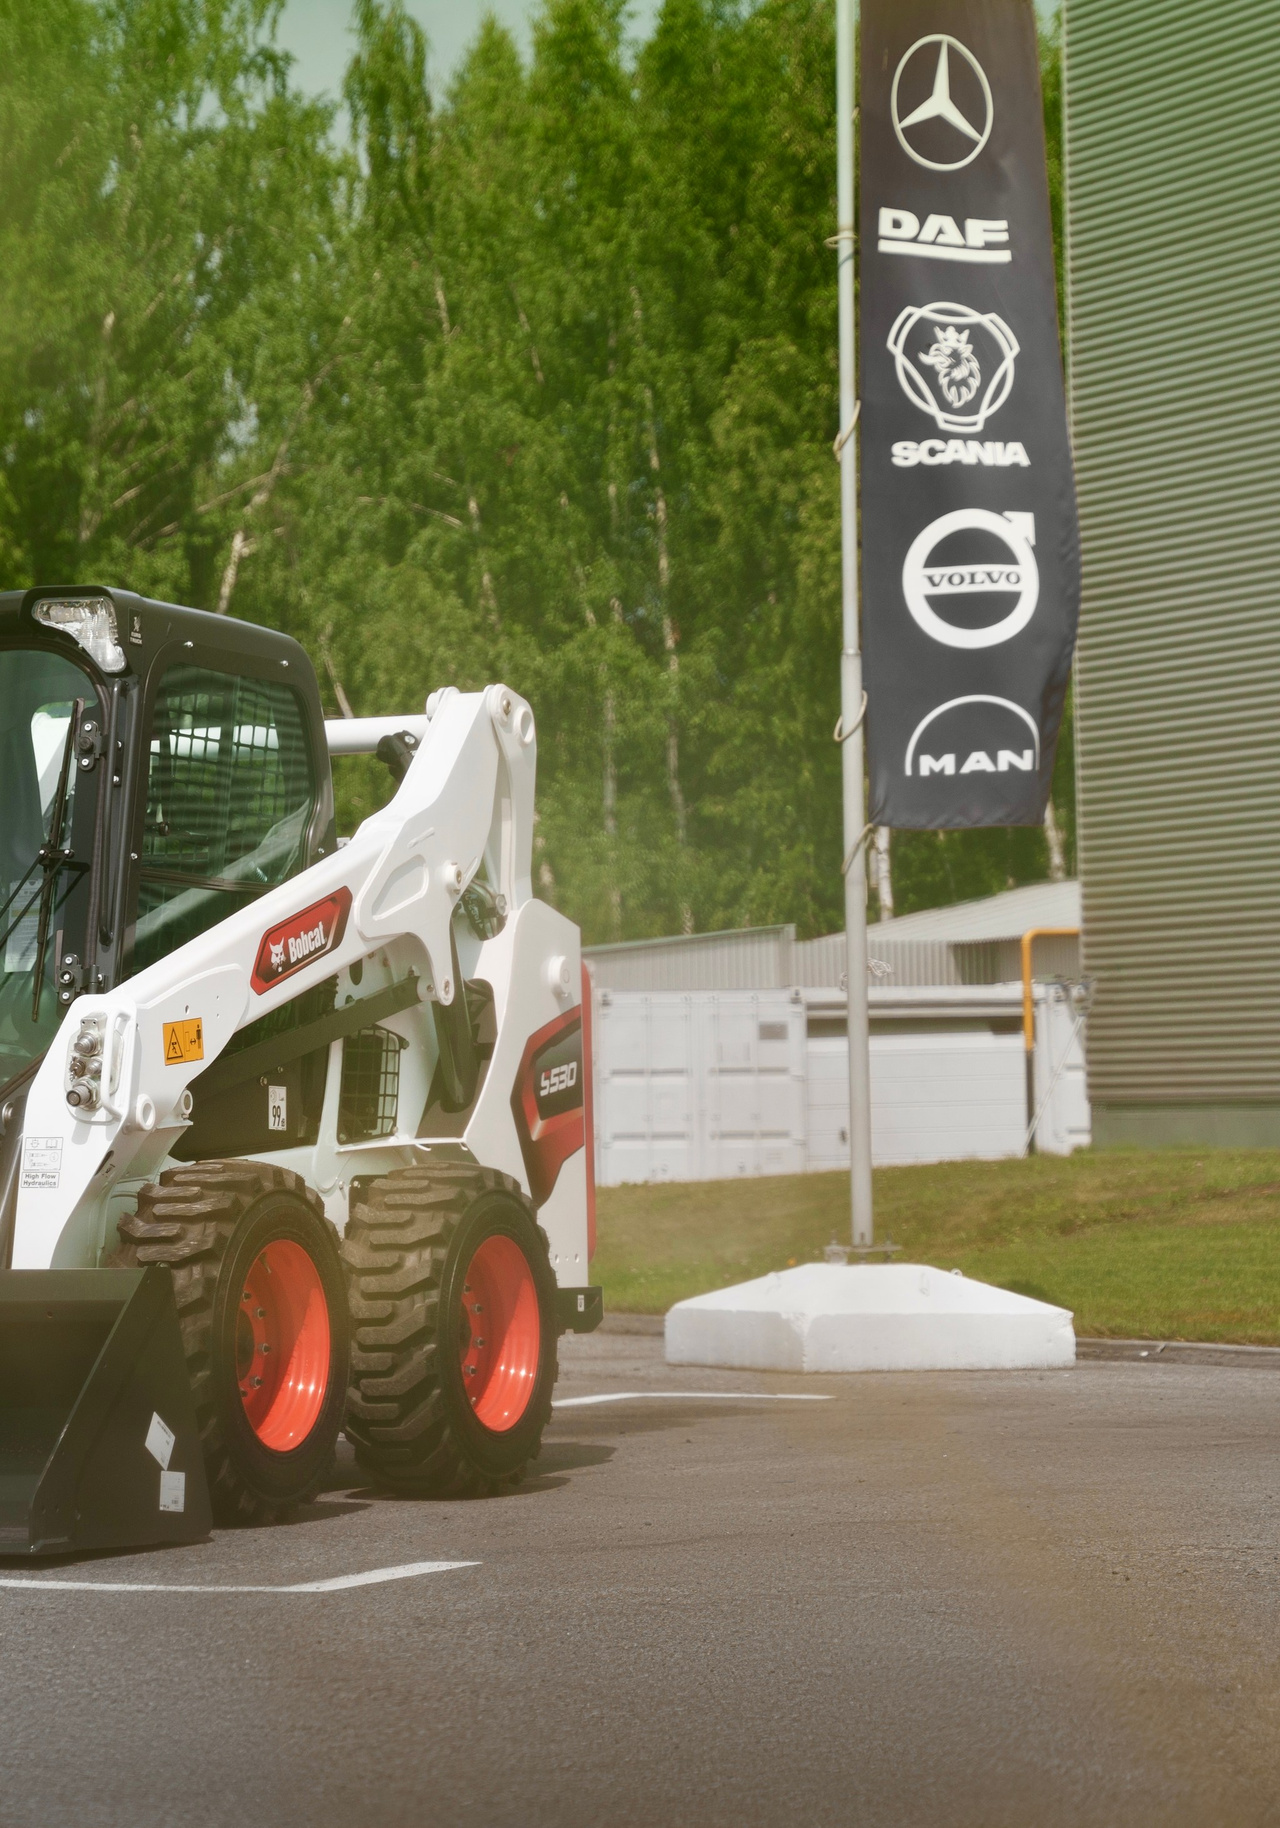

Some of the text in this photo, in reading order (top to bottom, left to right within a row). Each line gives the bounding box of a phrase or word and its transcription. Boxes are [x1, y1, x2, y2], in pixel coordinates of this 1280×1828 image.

[878, 207, 1009, 247] DAF
[891, 439, 1031, 468] SCANIA
[926, 570, 1022, 588] VOLVO
[919, 749, 1034, 776] MAN
[287, 921, 326, 964] Bobcat
[540, 1061, 578, 1097] S530
[272, 1105, 281, 1127] 99
[23, 1179, 57, 1187] Hydraulics
